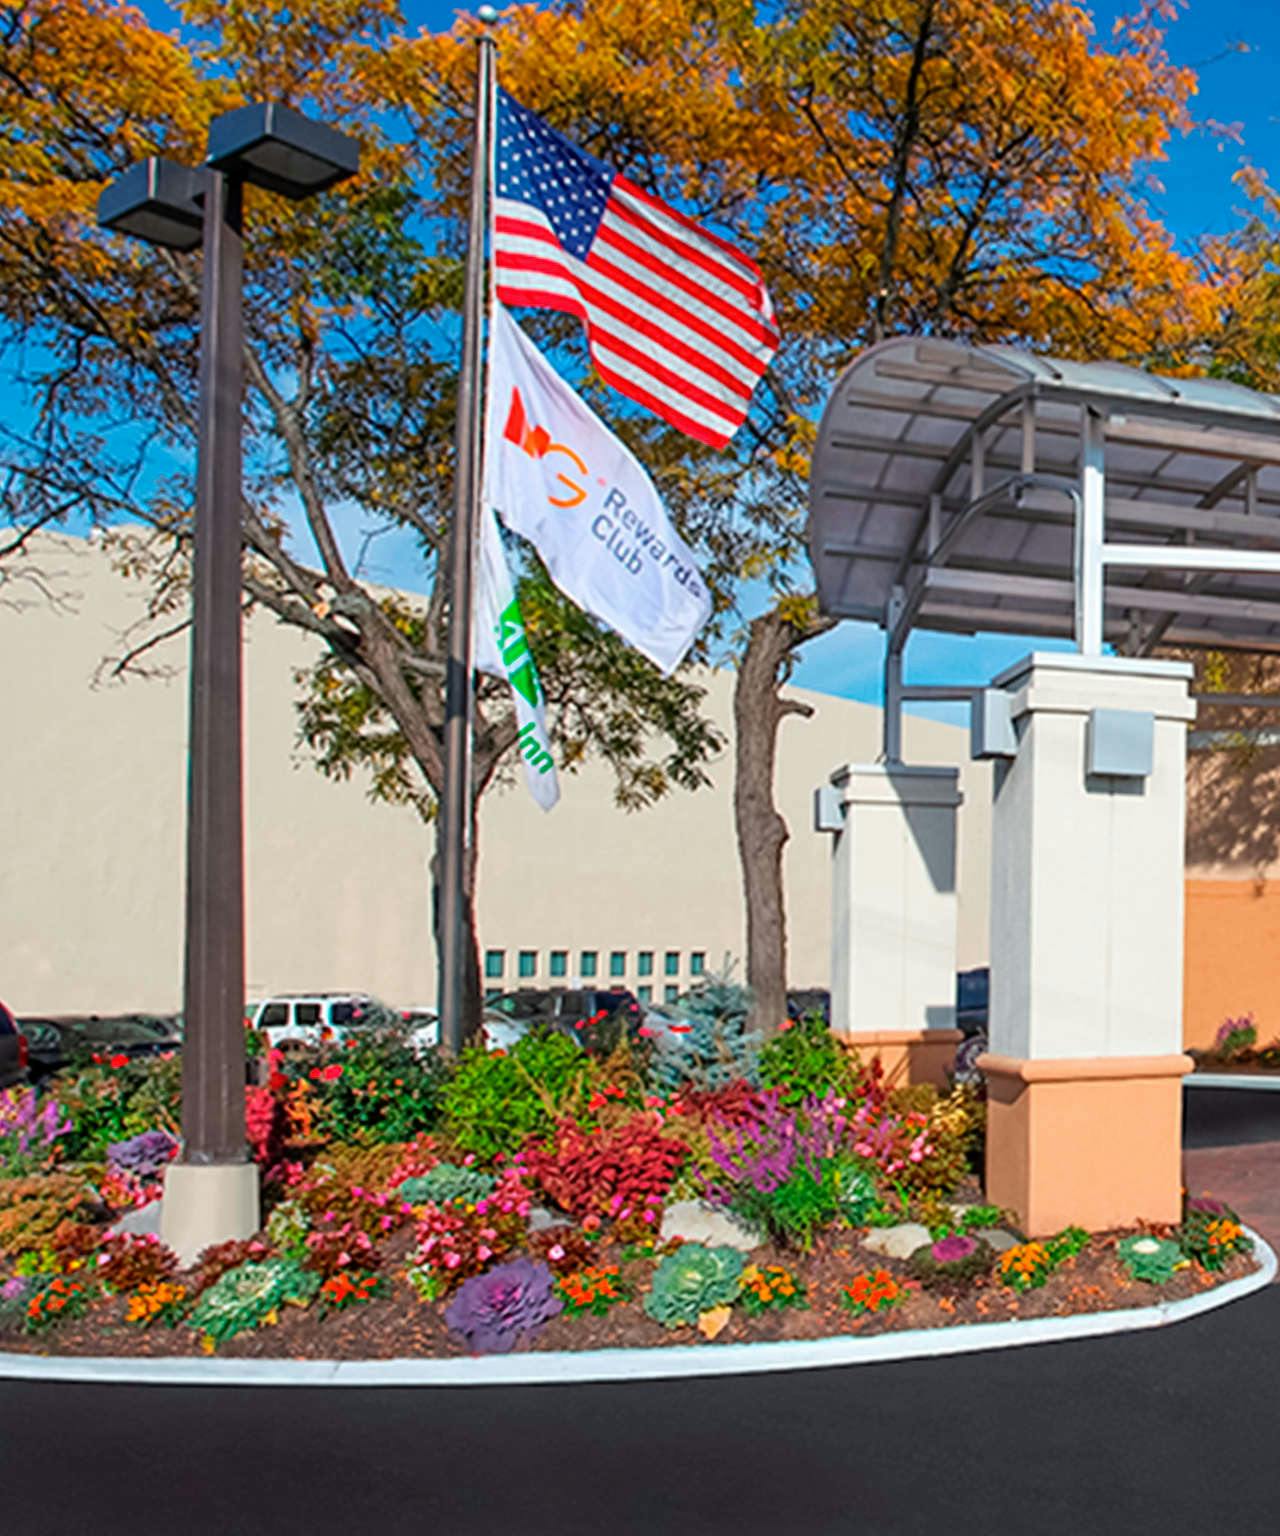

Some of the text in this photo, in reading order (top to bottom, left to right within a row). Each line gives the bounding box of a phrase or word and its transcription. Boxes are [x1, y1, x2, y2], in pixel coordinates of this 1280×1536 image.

[592, 514, 643, 575] Club
[604, 487, 701, 598] Rewards
[518, 721, 554, 775] Inn
